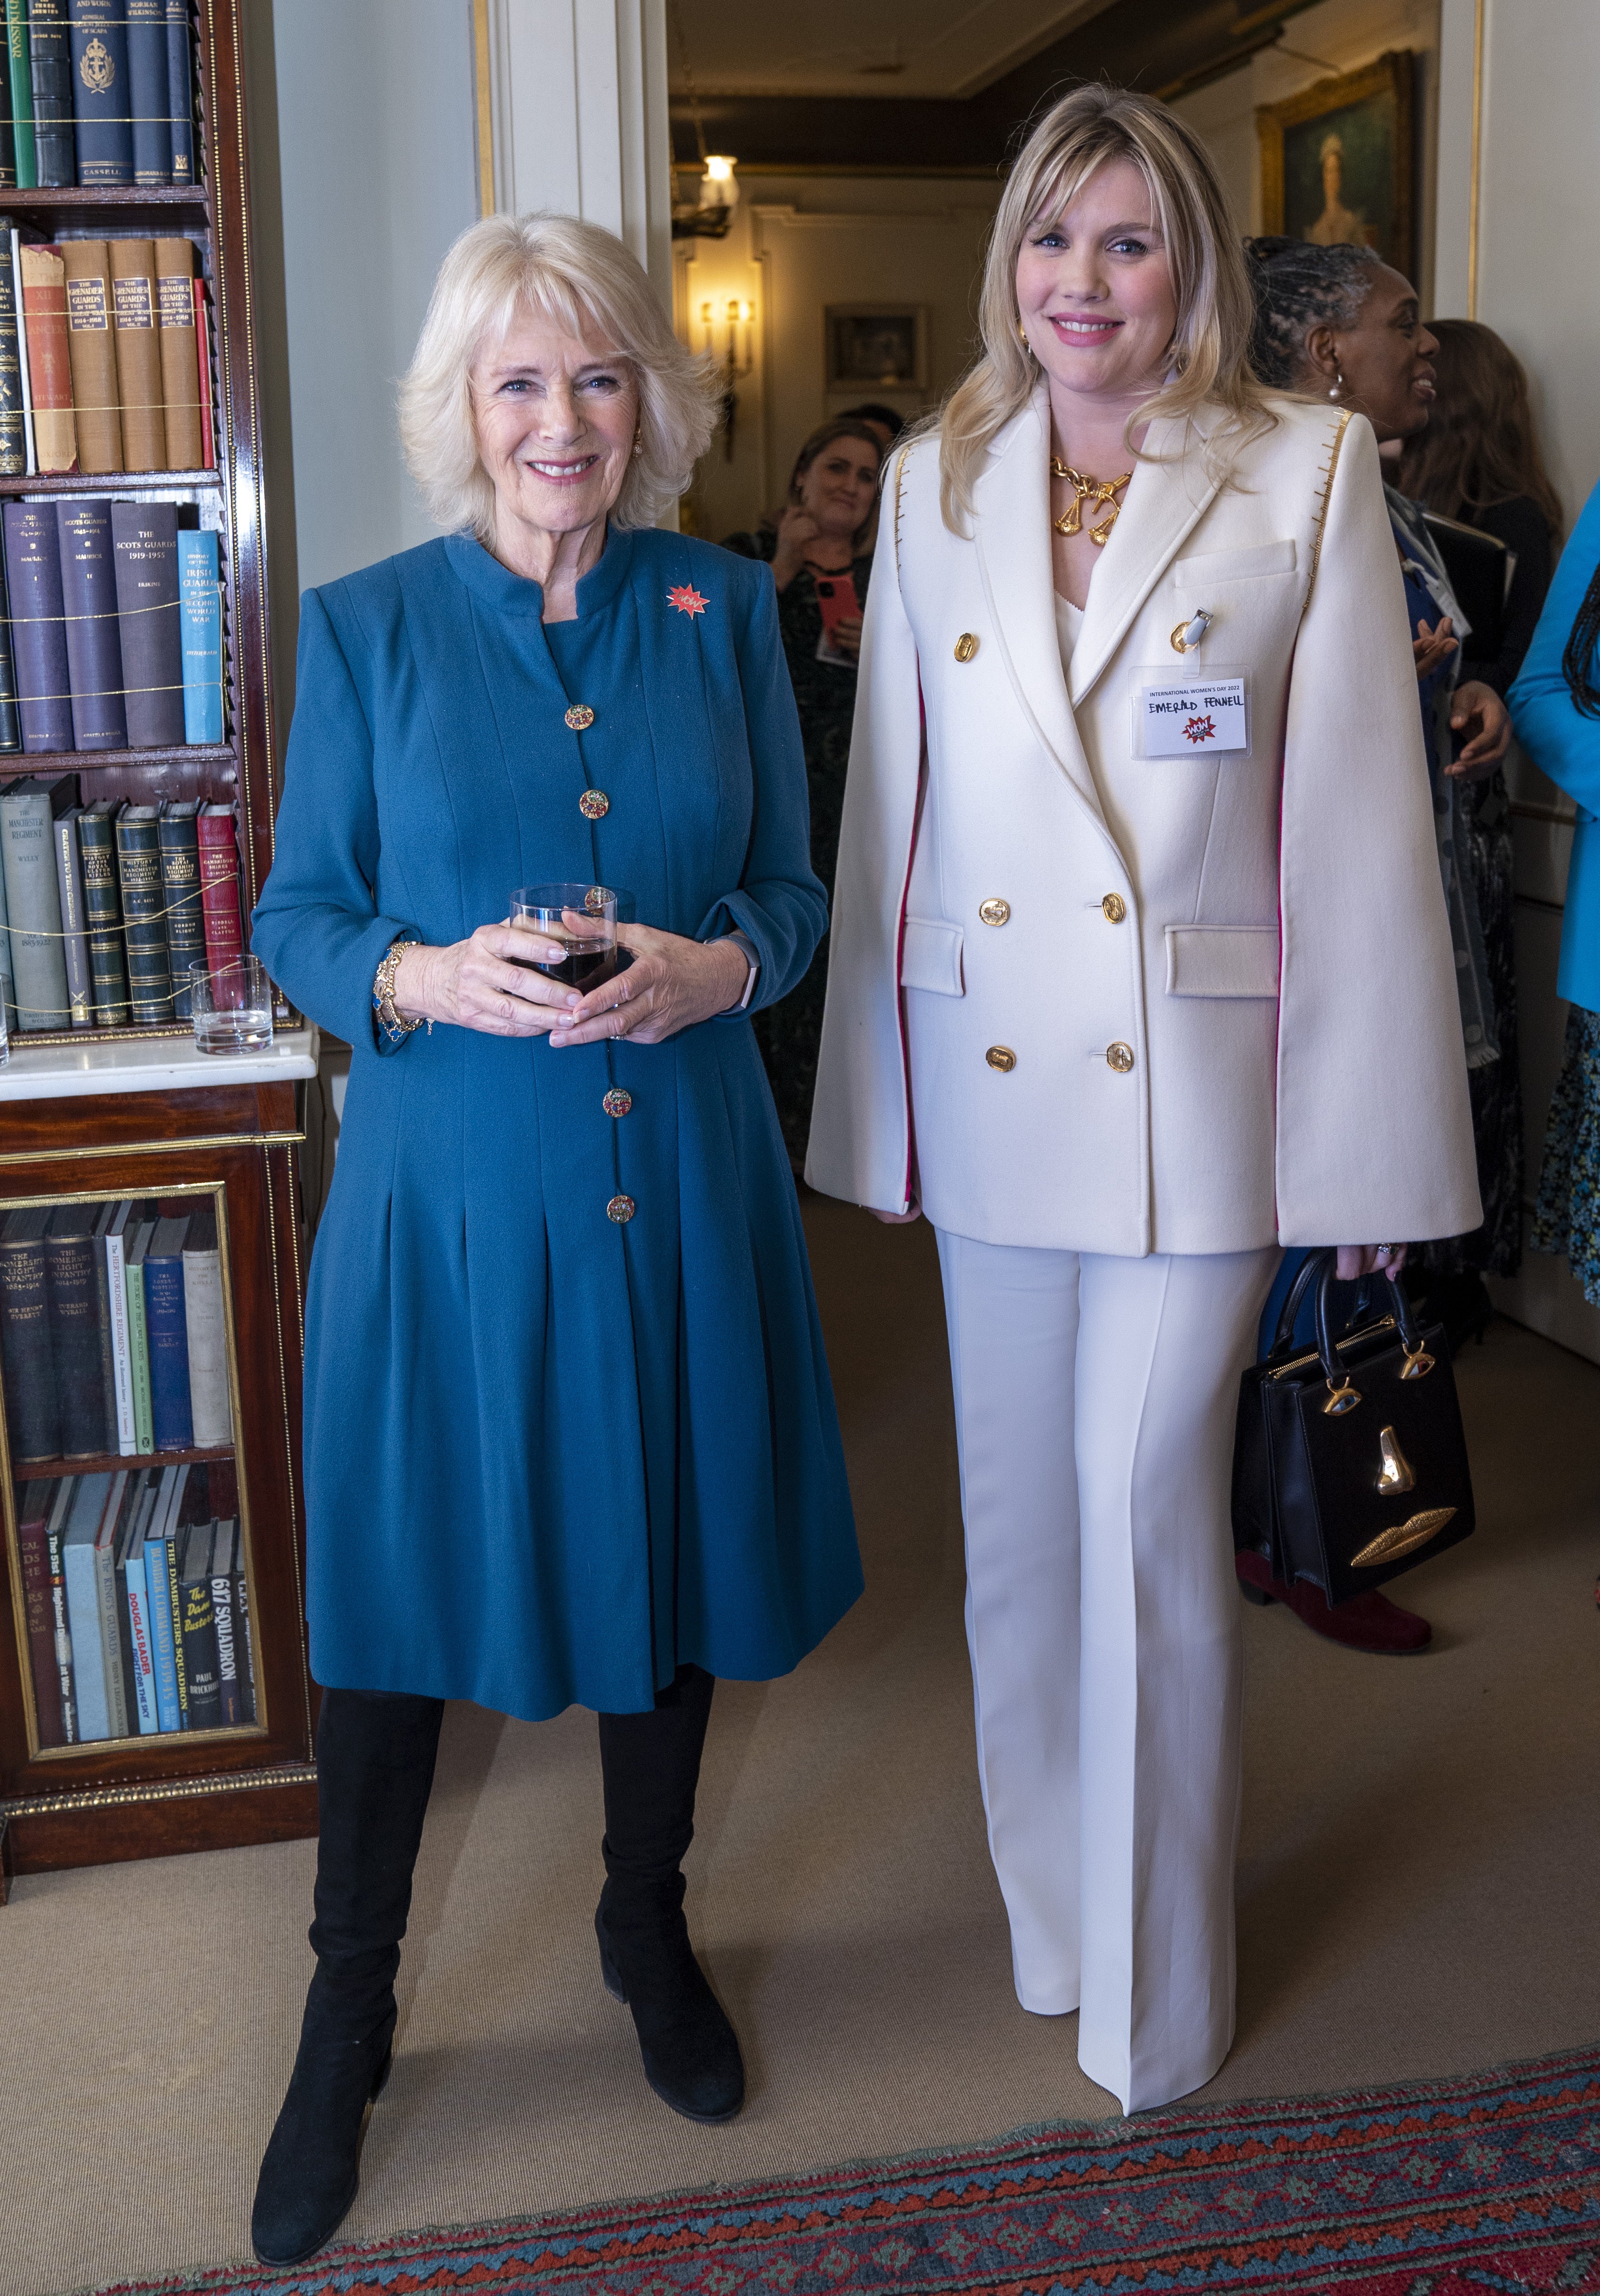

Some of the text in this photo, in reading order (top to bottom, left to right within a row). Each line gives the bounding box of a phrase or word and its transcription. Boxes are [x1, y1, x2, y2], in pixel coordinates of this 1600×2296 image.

[69, 287, 104, 296] GRENADIER
[115, 286, 148, 295] GRENADIER
[160, 294, 188, 302] GUARDS
[72, 296, 101, 304] GUARDS
[118, 295, 147, 304] GUARDS
[677, 591, 701, 608] WOW
[1149, 689, 1189, 697] INTERNATIONAL
[1148, 695, 1245, 713] EMERALD FENNELL
[1187, 719, 1209, 735] WOW
[9, 818, 43, 828] MANCHESTER
[12, 830, 42, 839] REGIMENT
[8, 1266, 36, 1275] LIGHT
[51, 1268, 91, 1278] INFANTRY
[57, 1263, 84, 1271] LIGHT
[2, 1272, 43, 1282] INFANTRY
[6, 1282, 40, 1291] 1685-1914
[113, 1255, 123, 1317] HERTFORDSHIRE
[135, 1302, 141, 1310] OF
[116, 1318, 125, 1356] REGIMENT
[167, 1541, 175, 1566] THE
[102, 1559, 111, 1572] The
[103, 1577, 114, 1611] KING'S
[189, 1586, 206, 1601] The
[169, 1568, 182, 1645] DAMBUSTERS
[187, 1601, 210, 1616] Dam
[49, 1536, 70, 1696] The 51st Highland Division at War
[150, 1547, 174, 1700] BOMBER COMMAND 1939-45
[184, 1611, 214, 1633] Busters
[106, 1614, 119, 1656] GUARDS
[128, 1593, 151, 1676] DOUGLAS BADER
[211, 1578, 236, 1681] 617 SQUADRON
[132, 1648, 141, 1671] FIGHT
[175, 1647, 188, 1710] SQUADRON
[195, 1672, 212, 1684] PAUL
[139, 1688, 147, 1703] THE
[141, 1703, 150, 1718] SKY
